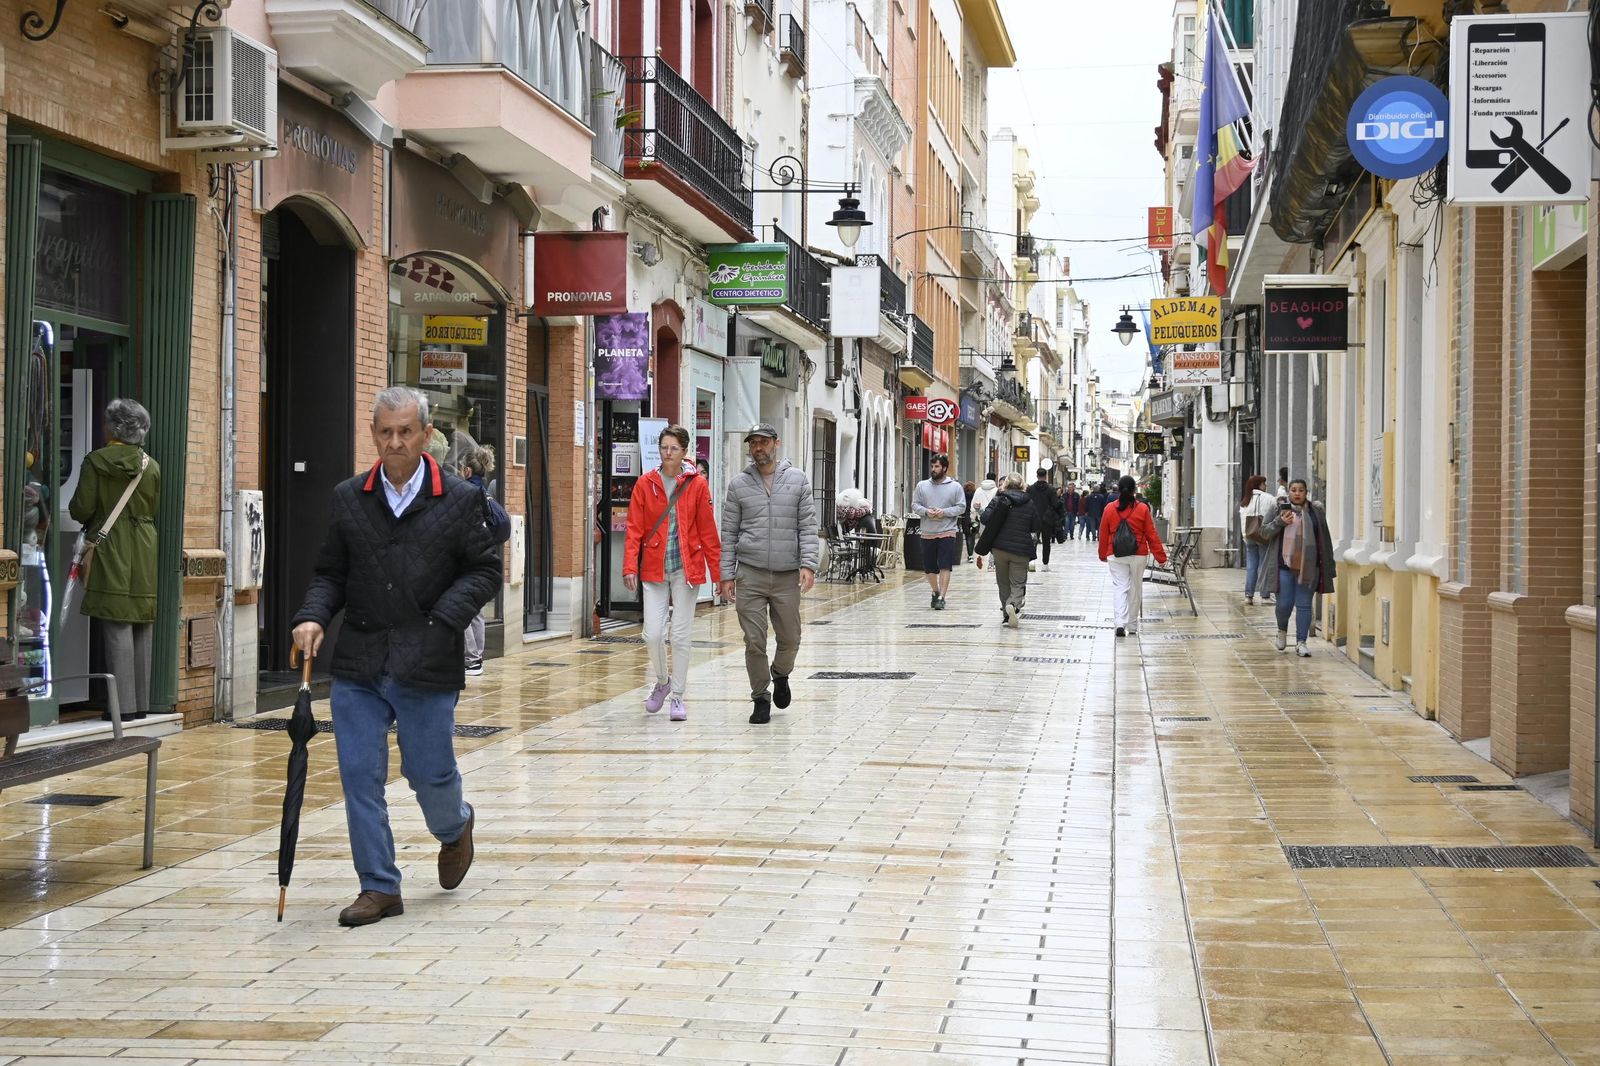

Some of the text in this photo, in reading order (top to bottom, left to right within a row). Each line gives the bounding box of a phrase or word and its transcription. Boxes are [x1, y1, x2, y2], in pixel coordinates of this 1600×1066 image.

[1495, 109, 1538, 117] personalizada
[1356, 121, 1444, 140] DIGI
[281, 117, 357, 174] PRONOVIAS
[1155, 208, 1167, 242] DUPLA
[742, 260, 786, 272] Herbolario
[740, 271, 786, 287] Equinácea
[547, 292, 612, 302] PRONOVIAS
[1153, 301, 1217, 320] ALDEMAR
[1154, 324, 1218, 339] PELUQUEROS
[598, 348, 644, 357] PLANETA
[906, 402, 926, 410] GAES
